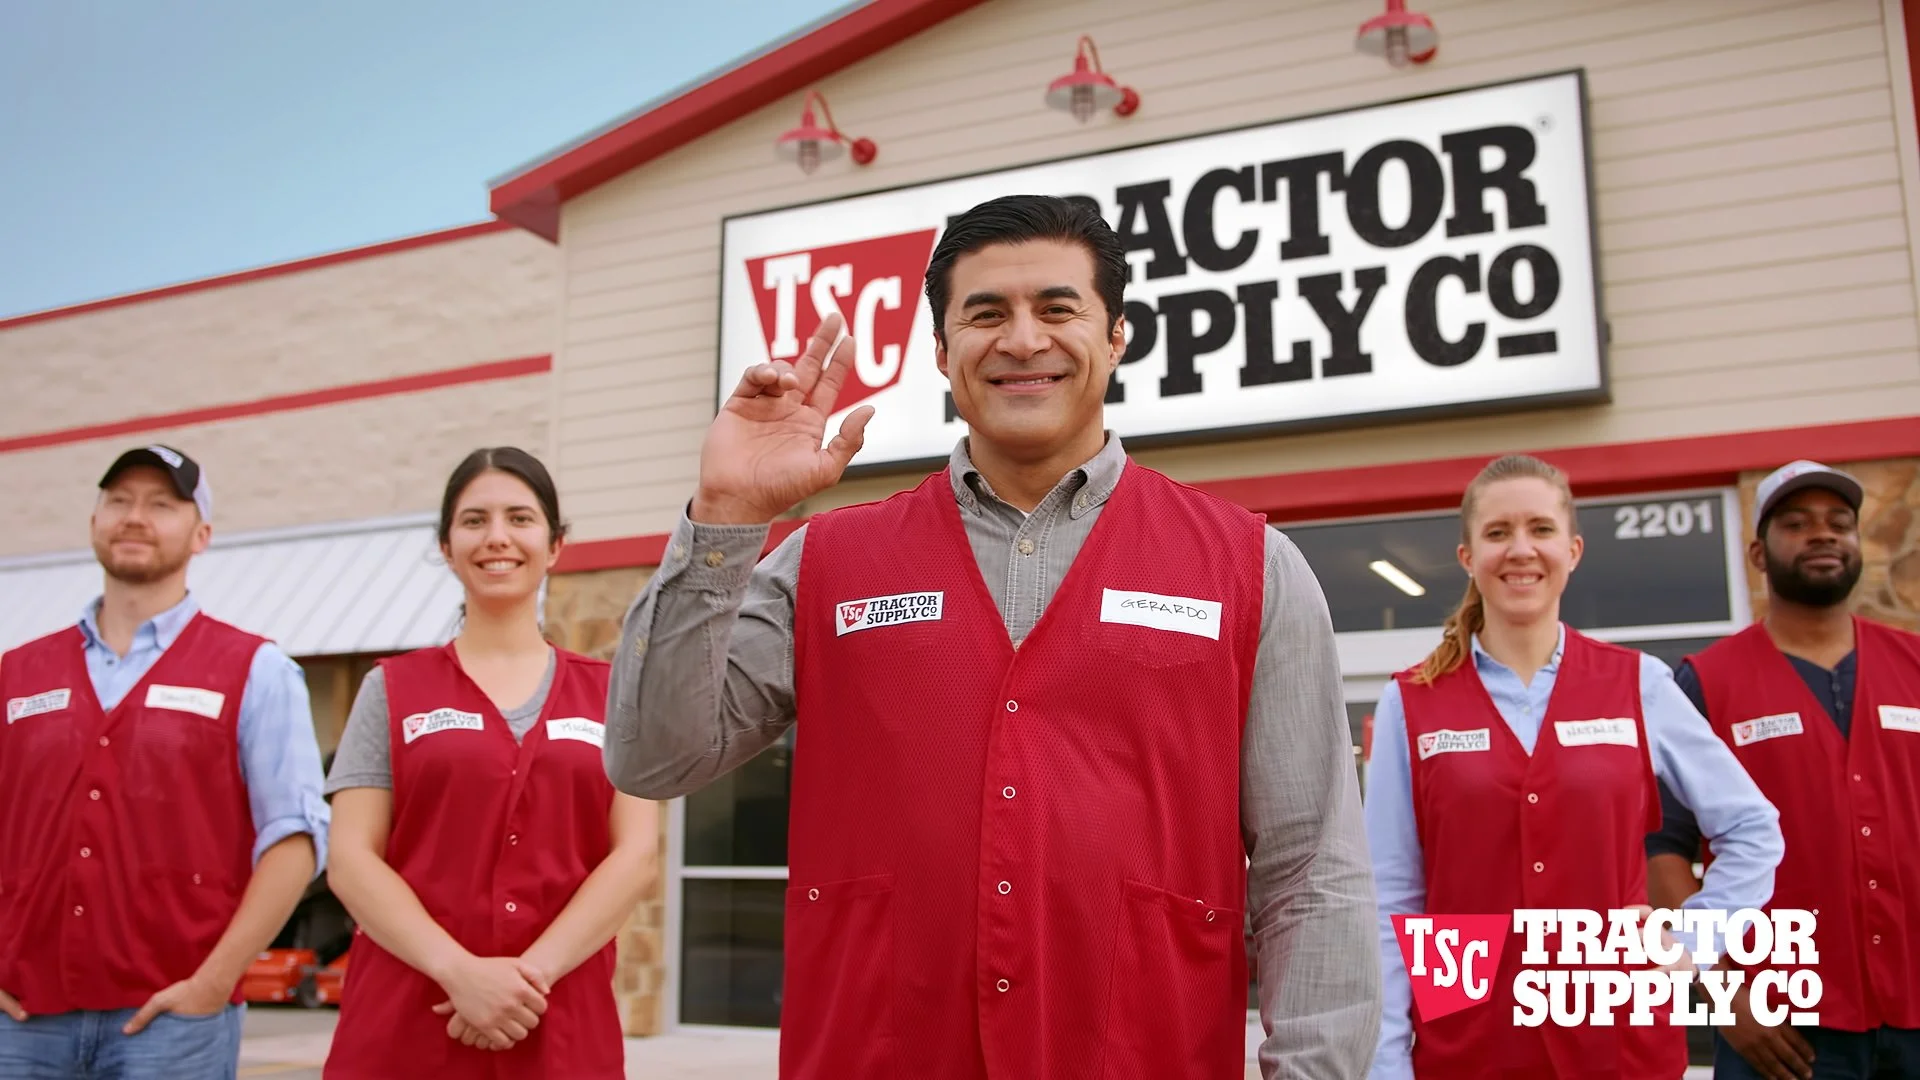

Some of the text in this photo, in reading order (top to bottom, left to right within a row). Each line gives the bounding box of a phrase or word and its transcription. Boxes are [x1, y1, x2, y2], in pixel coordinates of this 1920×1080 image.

[946, 125, 1547, 284] ACTOR
[763, 252, 901, 388] TSC
[1614, 501, 1713, 539] 2201
[870, 596, 937, 612] TRACTOR
[1121, 599, 1207, 620] GERARDO
[842, 606, 863, 621] TSC
[867, 608, 920, 625] SUPPLY
[1438, 732, 1485, 741] TRACTOR
[1437, 741, 1473, 750] SUPPLY
